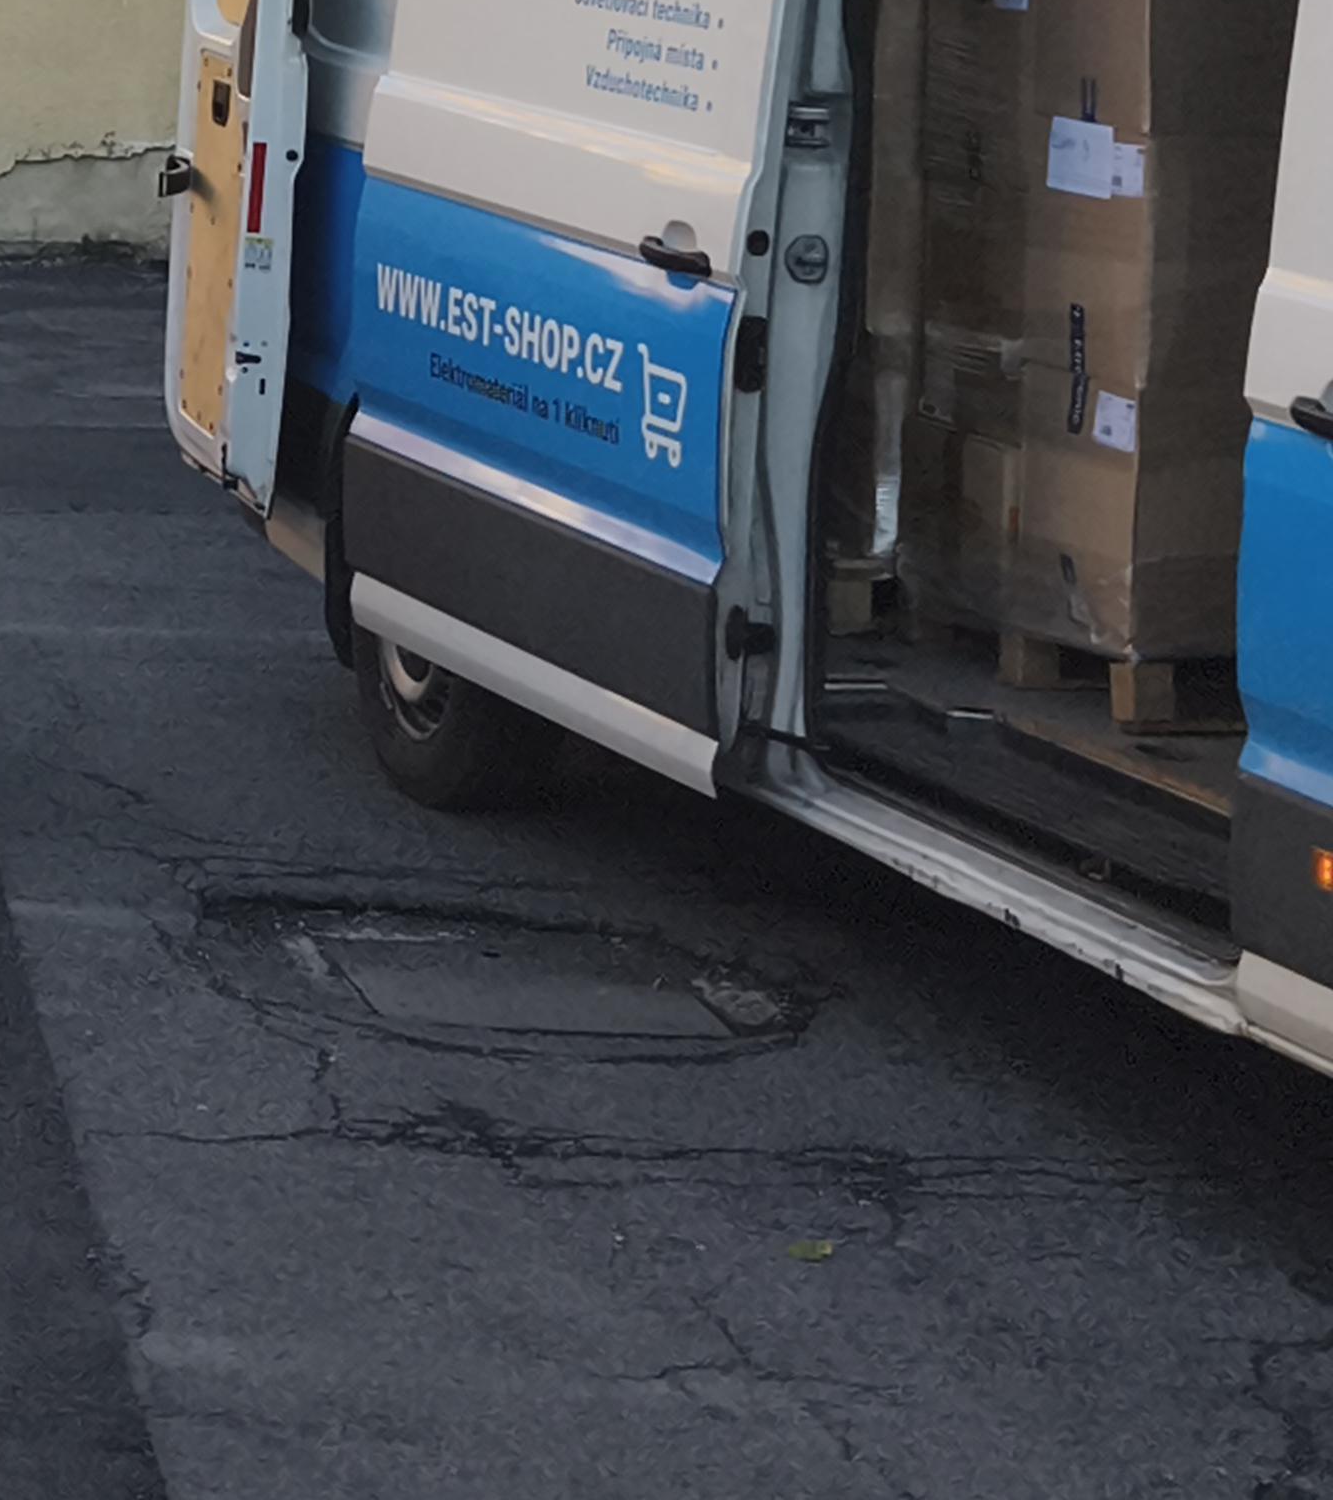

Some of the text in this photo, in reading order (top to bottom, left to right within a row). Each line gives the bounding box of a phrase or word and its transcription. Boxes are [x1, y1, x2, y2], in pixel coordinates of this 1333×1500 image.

[652, 0, 711, 29] technika
[586, 64, 699, 112] Vzduchotechnika
[376, 262, 624, 392] WWW.EST-SHOP.CZ
[532, 395, 549, 420] na
[552, 398, 561, 423] 1
